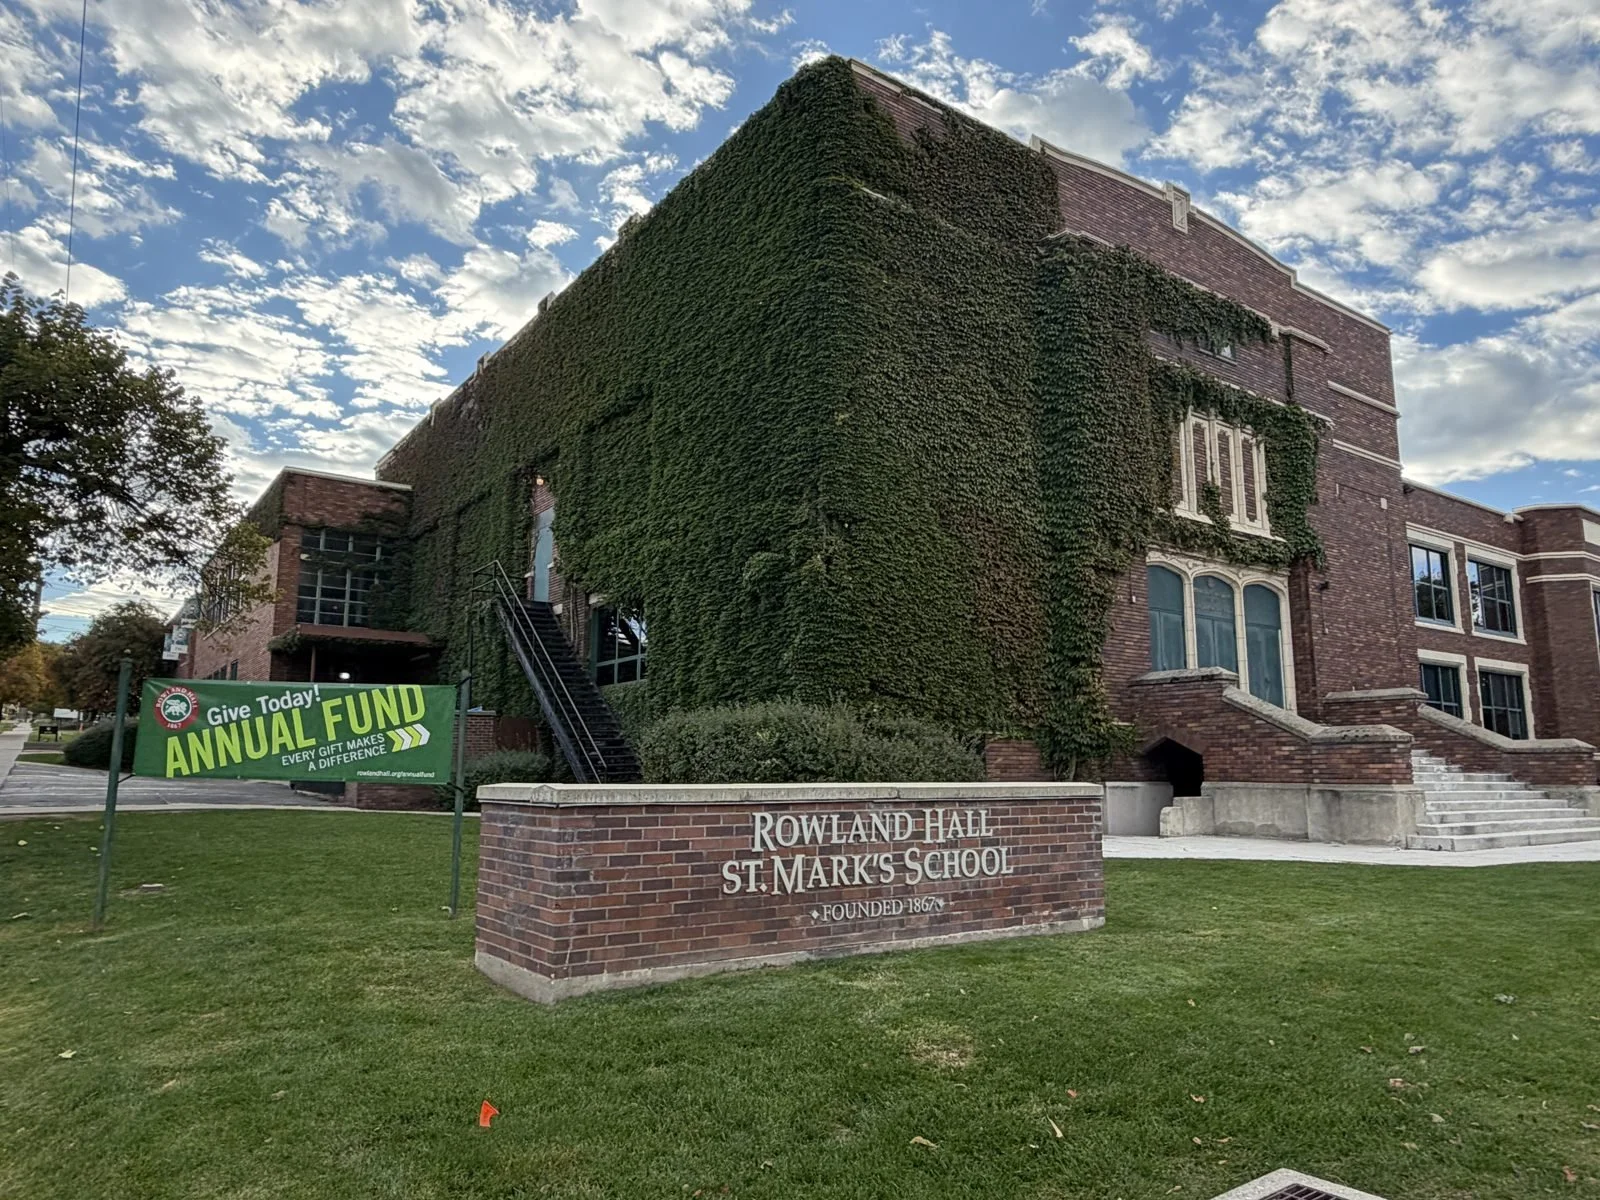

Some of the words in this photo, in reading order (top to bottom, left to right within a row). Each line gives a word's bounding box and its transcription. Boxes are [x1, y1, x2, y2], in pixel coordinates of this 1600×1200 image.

[207, 705, 251, 726] Give
[256, 684, 321, 714] Today!
[166, 708, 317, 778] ANNUAL
[321, 685, 426, 741] FUND
[282, 749, 315, 766] EVERY
[319, 742, 343, 757] GIFT
[347, 733, 385, 750] MAKES
[308, 761, 316, 771] A
[319, 744, 387, 769] DIFFERENCE
[752, 812, 913, 852] ROWLAND
[922, 808, 993, 844] HALL
[904, 847, 1014, 885] SCHOOL
[822, 900, 903, 921] FOUNDED
[907, 896, 936, 913] 1867
